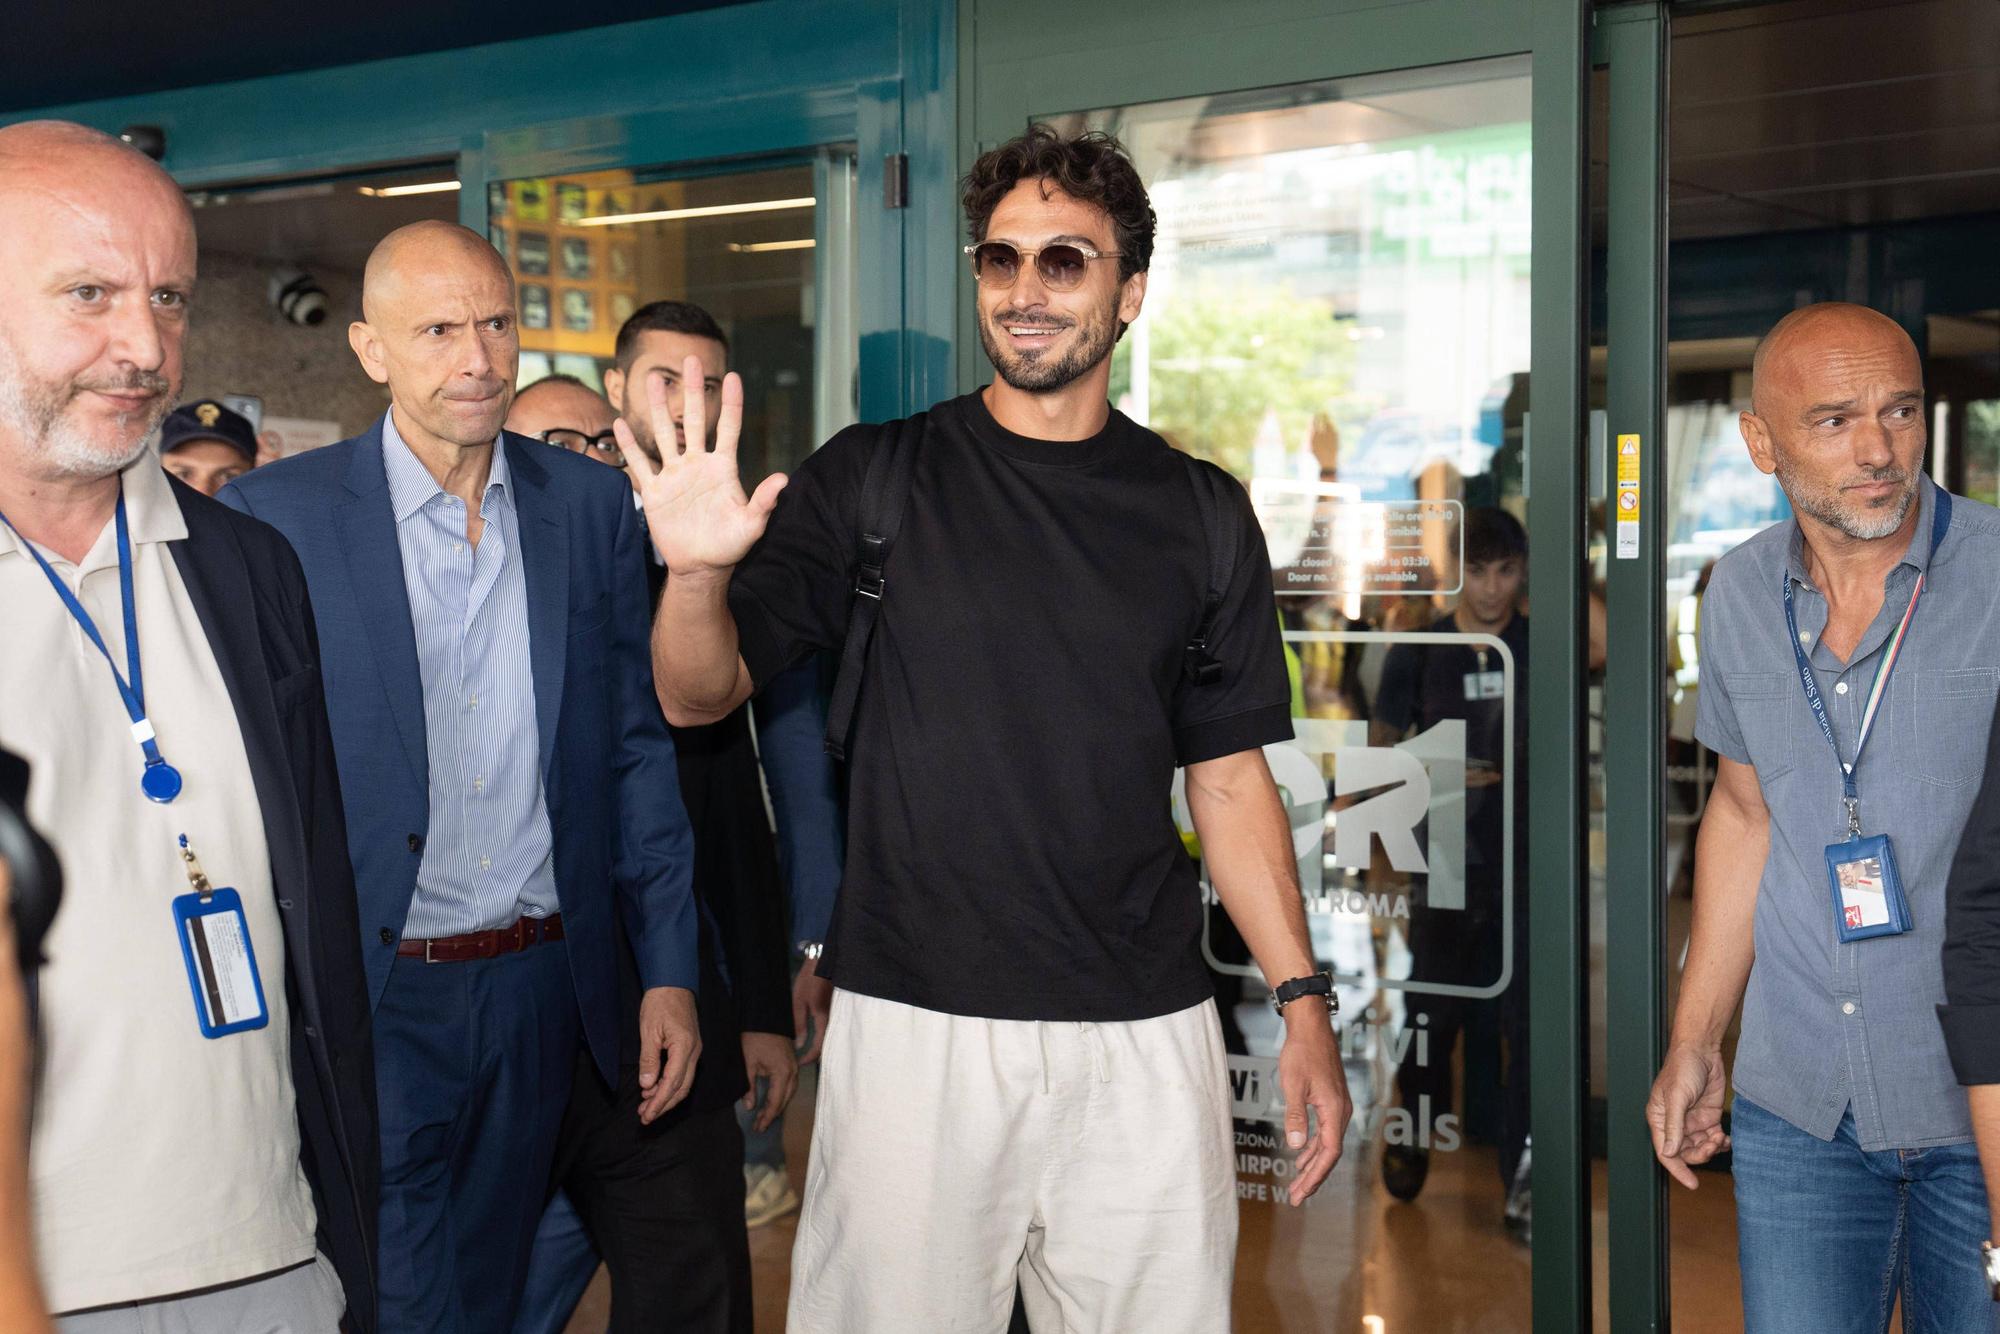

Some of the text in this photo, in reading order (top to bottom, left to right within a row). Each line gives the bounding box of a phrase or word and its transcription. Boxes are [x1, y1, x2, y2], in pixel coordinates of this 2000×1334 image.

[1302, 556, 1334, 569] closed
[1402, 555, 1430, 568] 03:30
[1287, 571, 1312, 583] Door
[1313, 573, 1329, 583] no.
[1375, 571, 1418, 583] available
[1803, 666, 1817, 698] Stato
[1811, 697, 1822, 710] di
[1329, 889, 1411, 919] ROMA
[1341, 1007, 1429, 1067] rivi
[1353, 1093, 1461, 1152] vals
[1232, 1132, 1277, 1149] ZIONA
